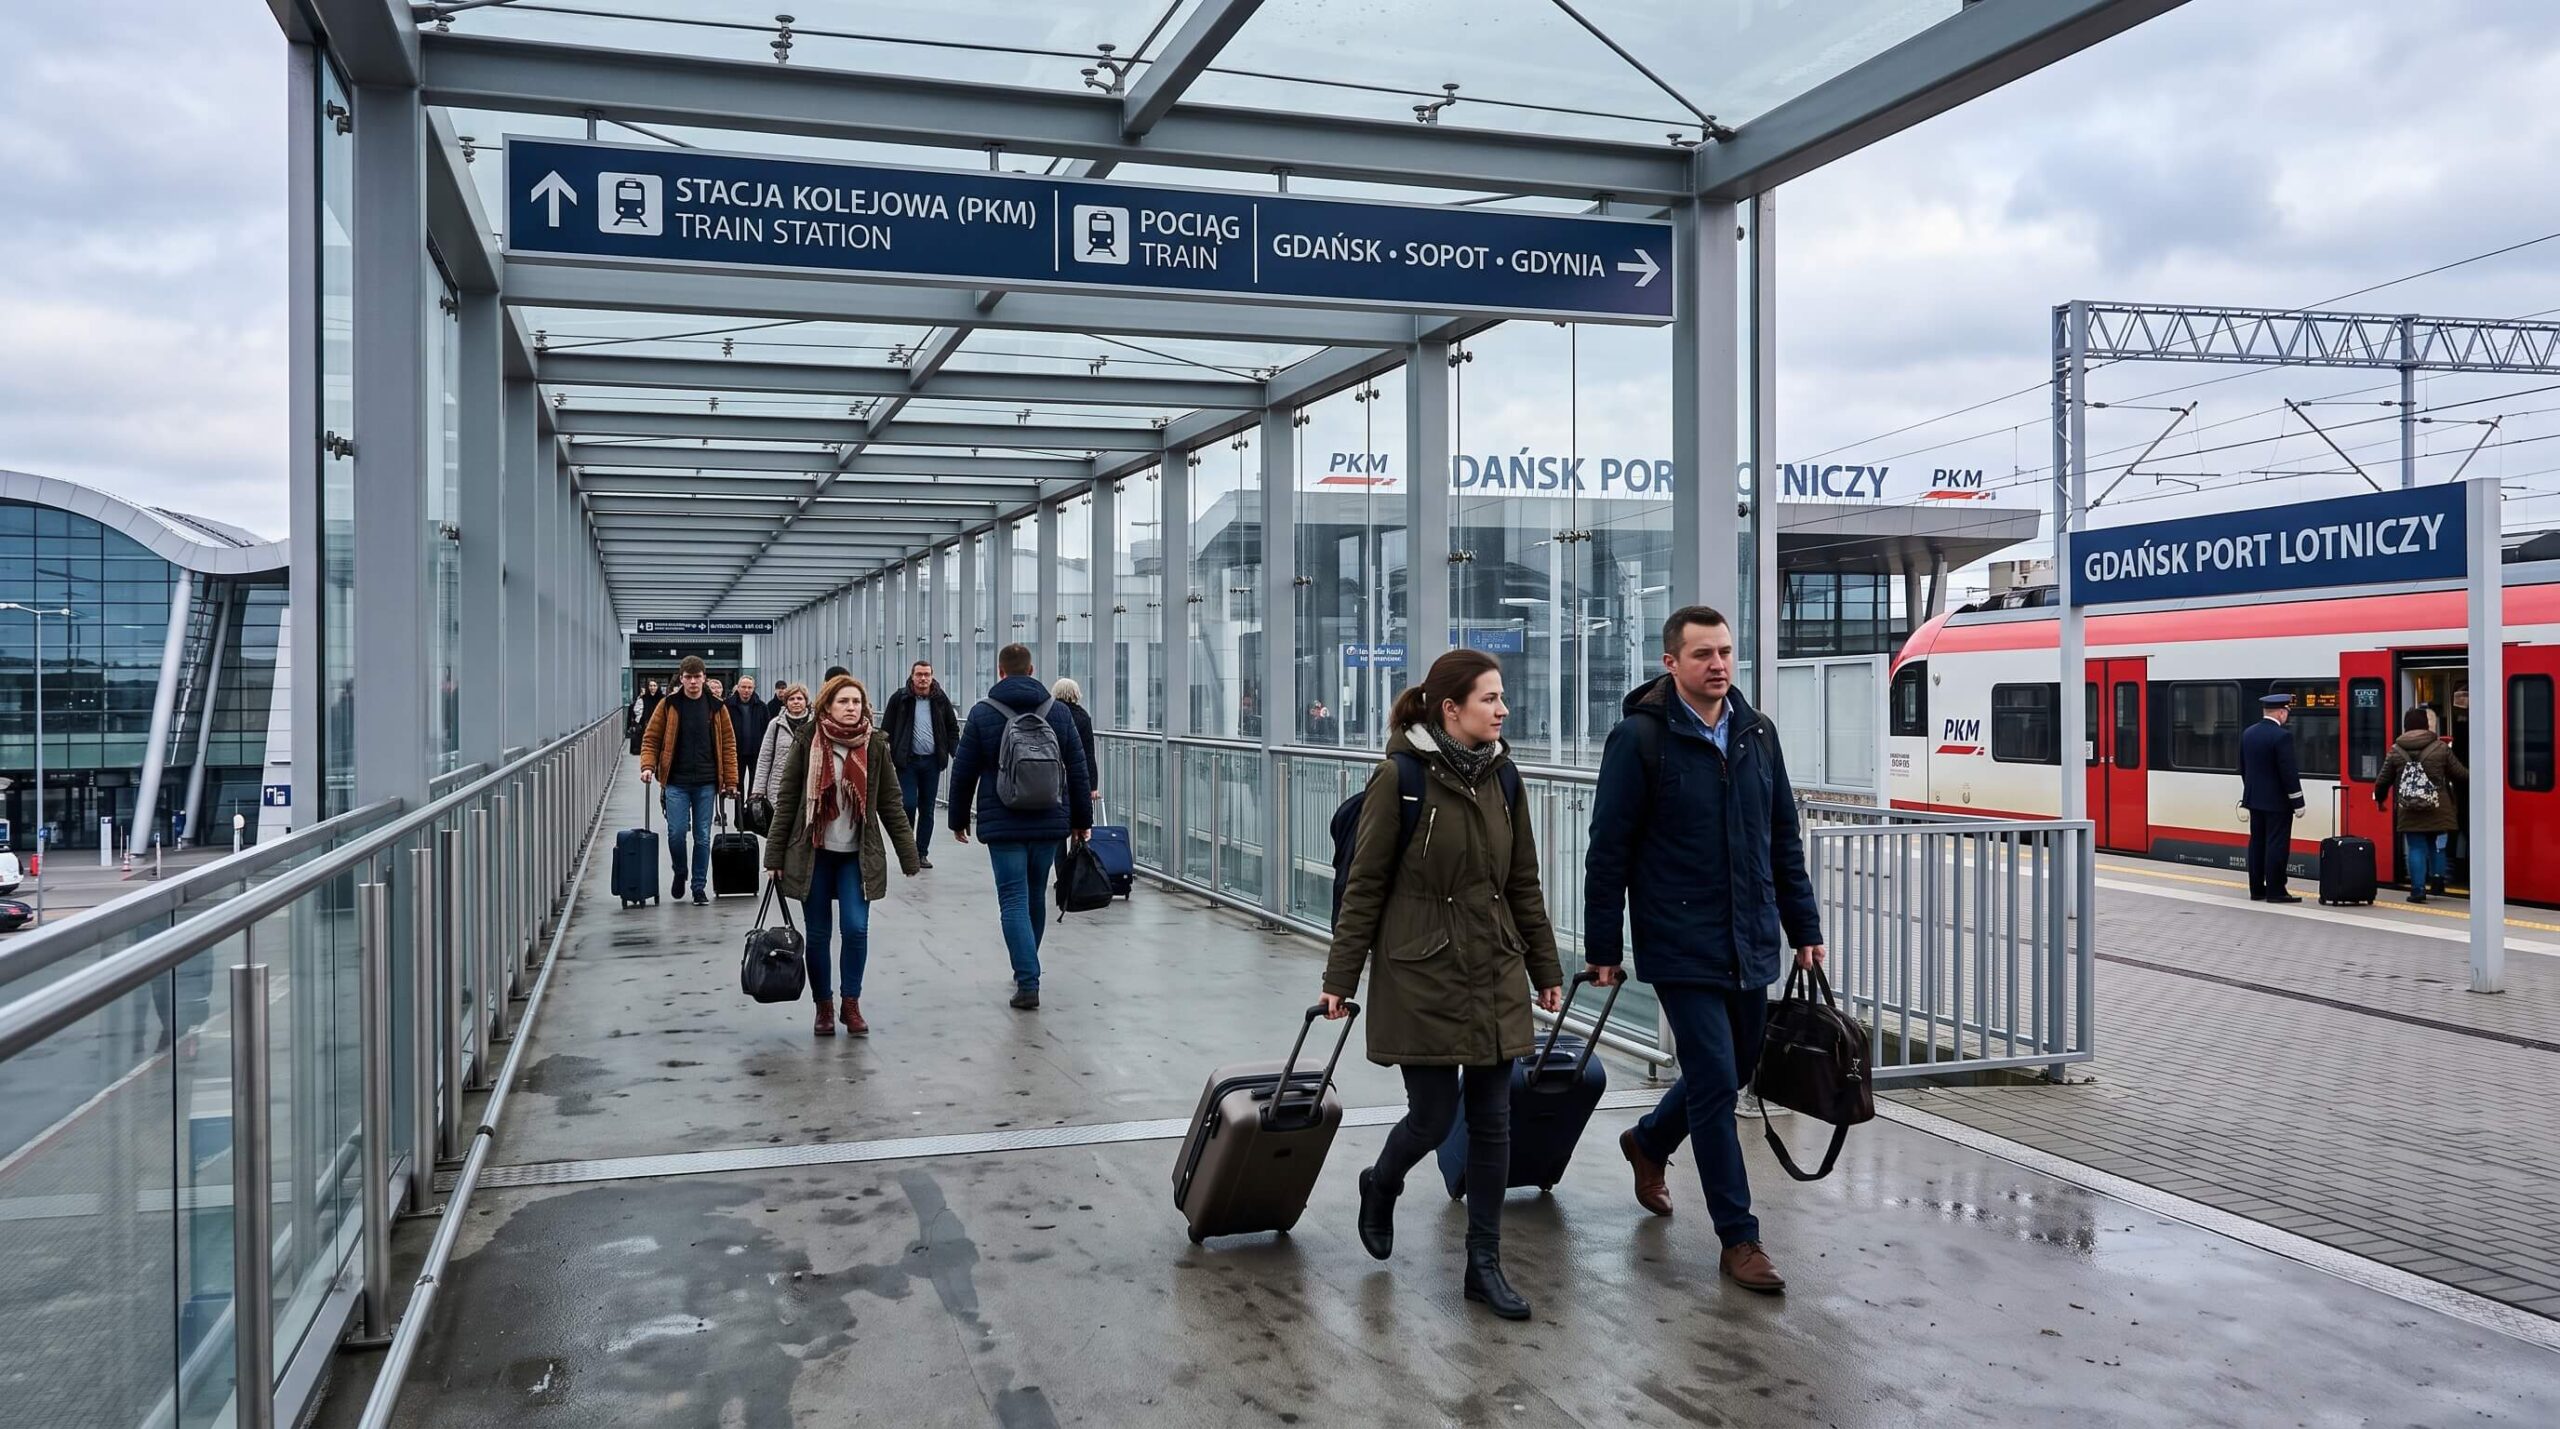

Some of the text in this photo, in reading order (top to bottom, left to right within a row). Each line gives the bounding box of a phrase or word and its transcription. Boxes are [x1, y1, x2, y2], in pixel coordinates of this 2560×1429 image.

[676, 177, 1036, 229] STACJA KOLEJOWA (PKM)
[675, 213, 891, 251] TRAIN STATION
[1140, 209, 1240, 245] POCIĄG
[1139, 241, 1218, 271] TRAIN
[1273, 231, 1606, 278] GDAŃSK SOPOT GDYNIA
[1329, 453, 1388, 473] PKM
[1452, 447, 1585, 491] DAŃSK
[1600, 458, 1673, 493] POR
[1931, 468, 1983, 488] PKM
[2084, 513, 2445, 582] GDAŃSK PORT LOTNICZY
[1943, 718, 1981, 742] PKM
